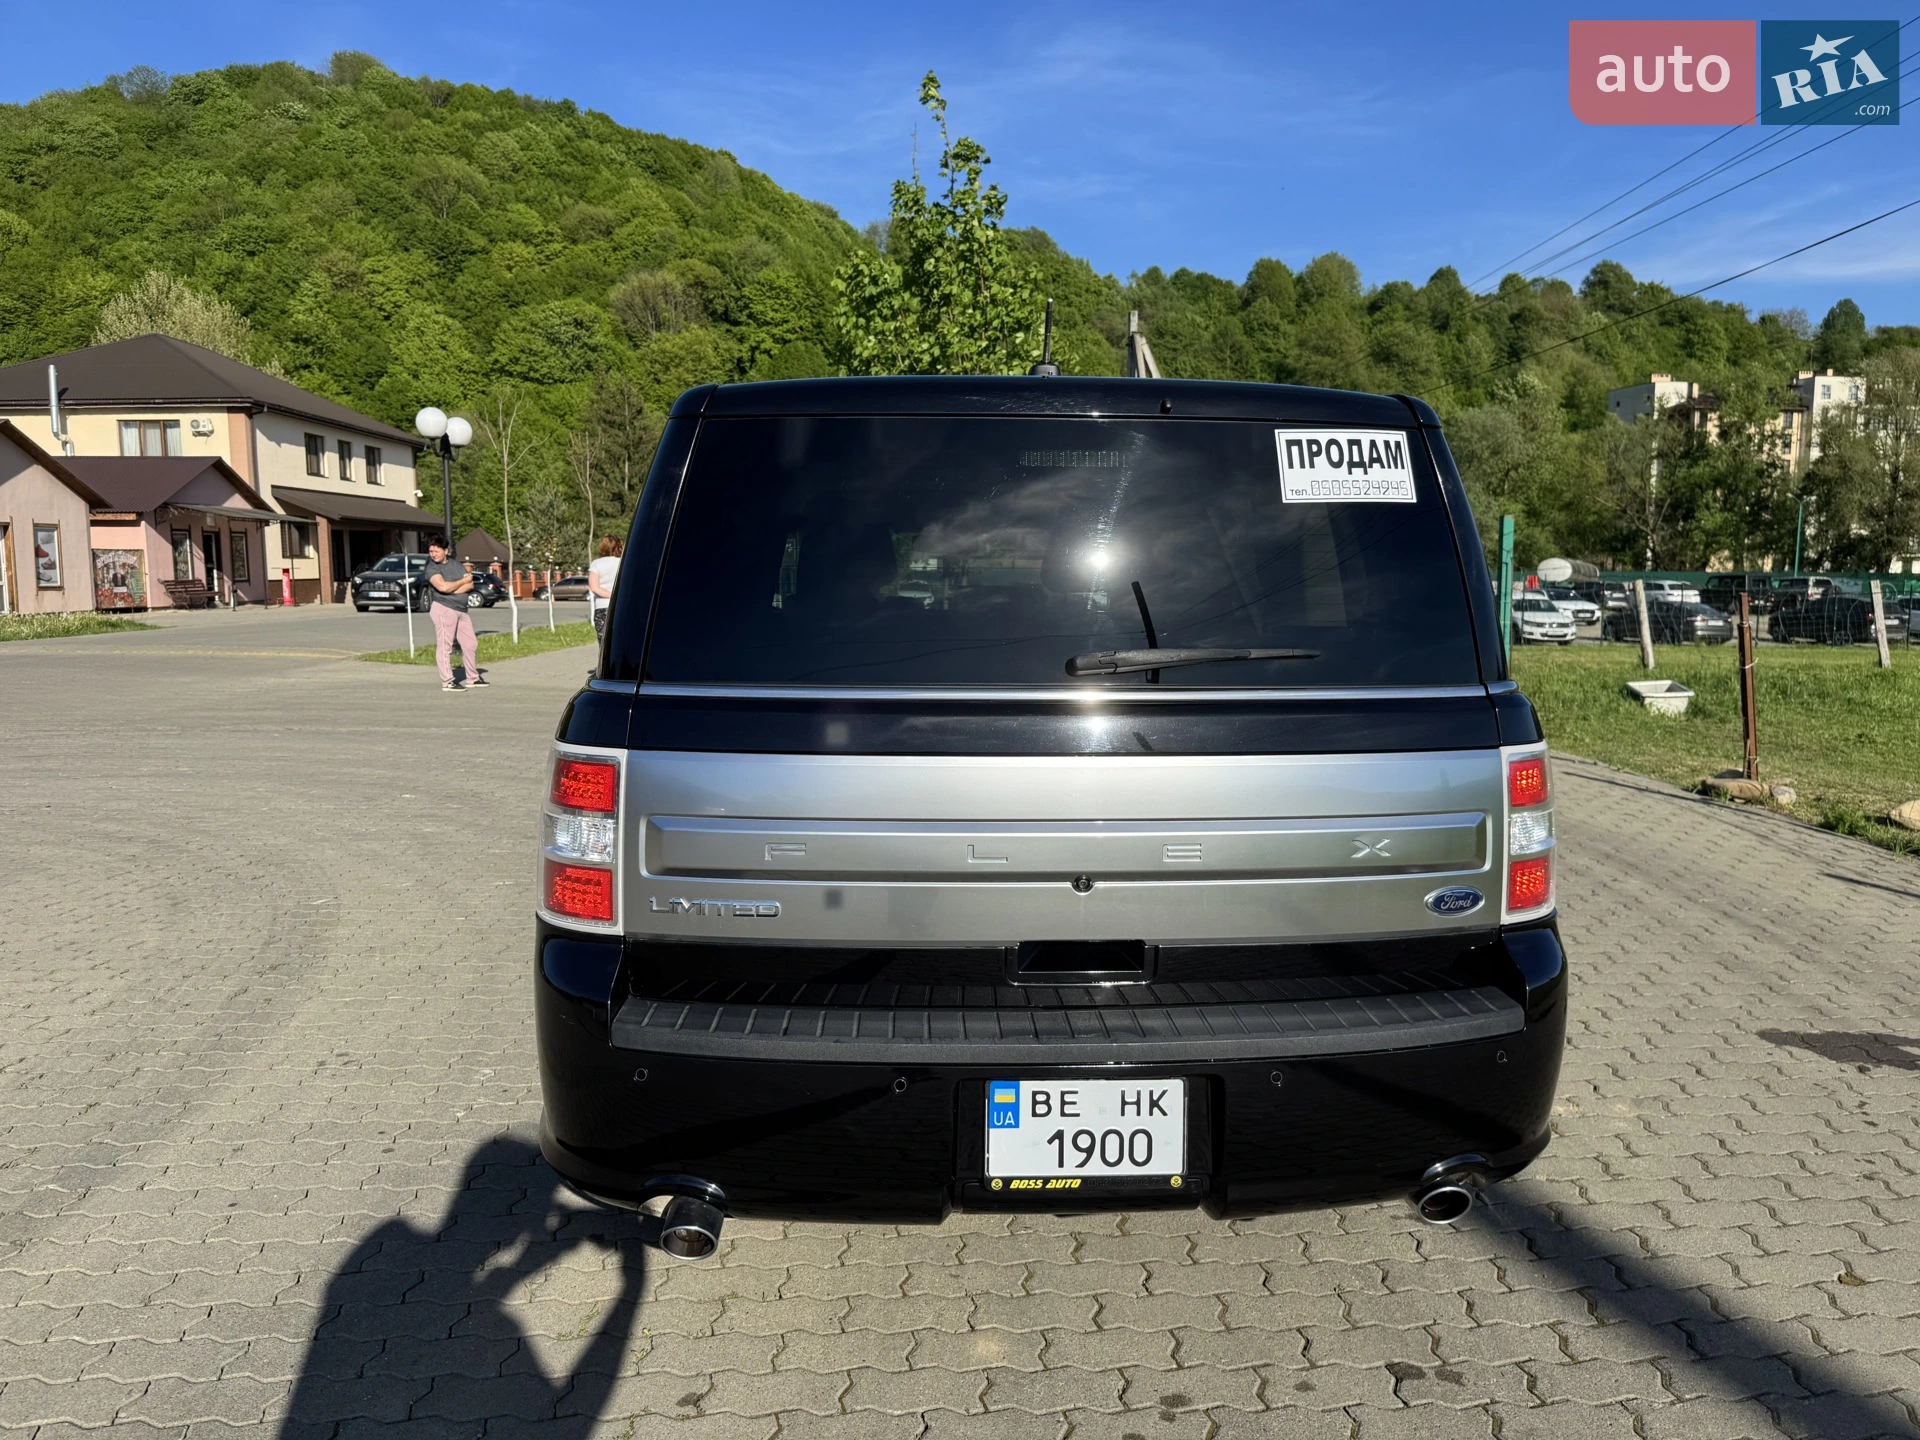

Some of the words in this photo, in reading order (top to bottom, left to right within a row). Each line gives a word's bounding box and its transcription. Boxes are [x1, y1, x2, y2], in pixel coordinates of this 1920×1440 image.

[1285, 438, 1406, 475] ПРОДАМ
[764, 838, 1392, 864] FLEX
[649, 896, 781, 917] LIMITED
[1440, 891, 1473, 910] Ford
[1031, 1090, 1081, 1118] BE
[1120, 1089, 1169, 1117] HK
[993, 1111, 1015, 1126] UA
[1046, 1128, 1153, 1168] 1900
[1009, 1179, 1044, 1189] BOSS
[1045, 1179, 1082, 1189] AUTO
